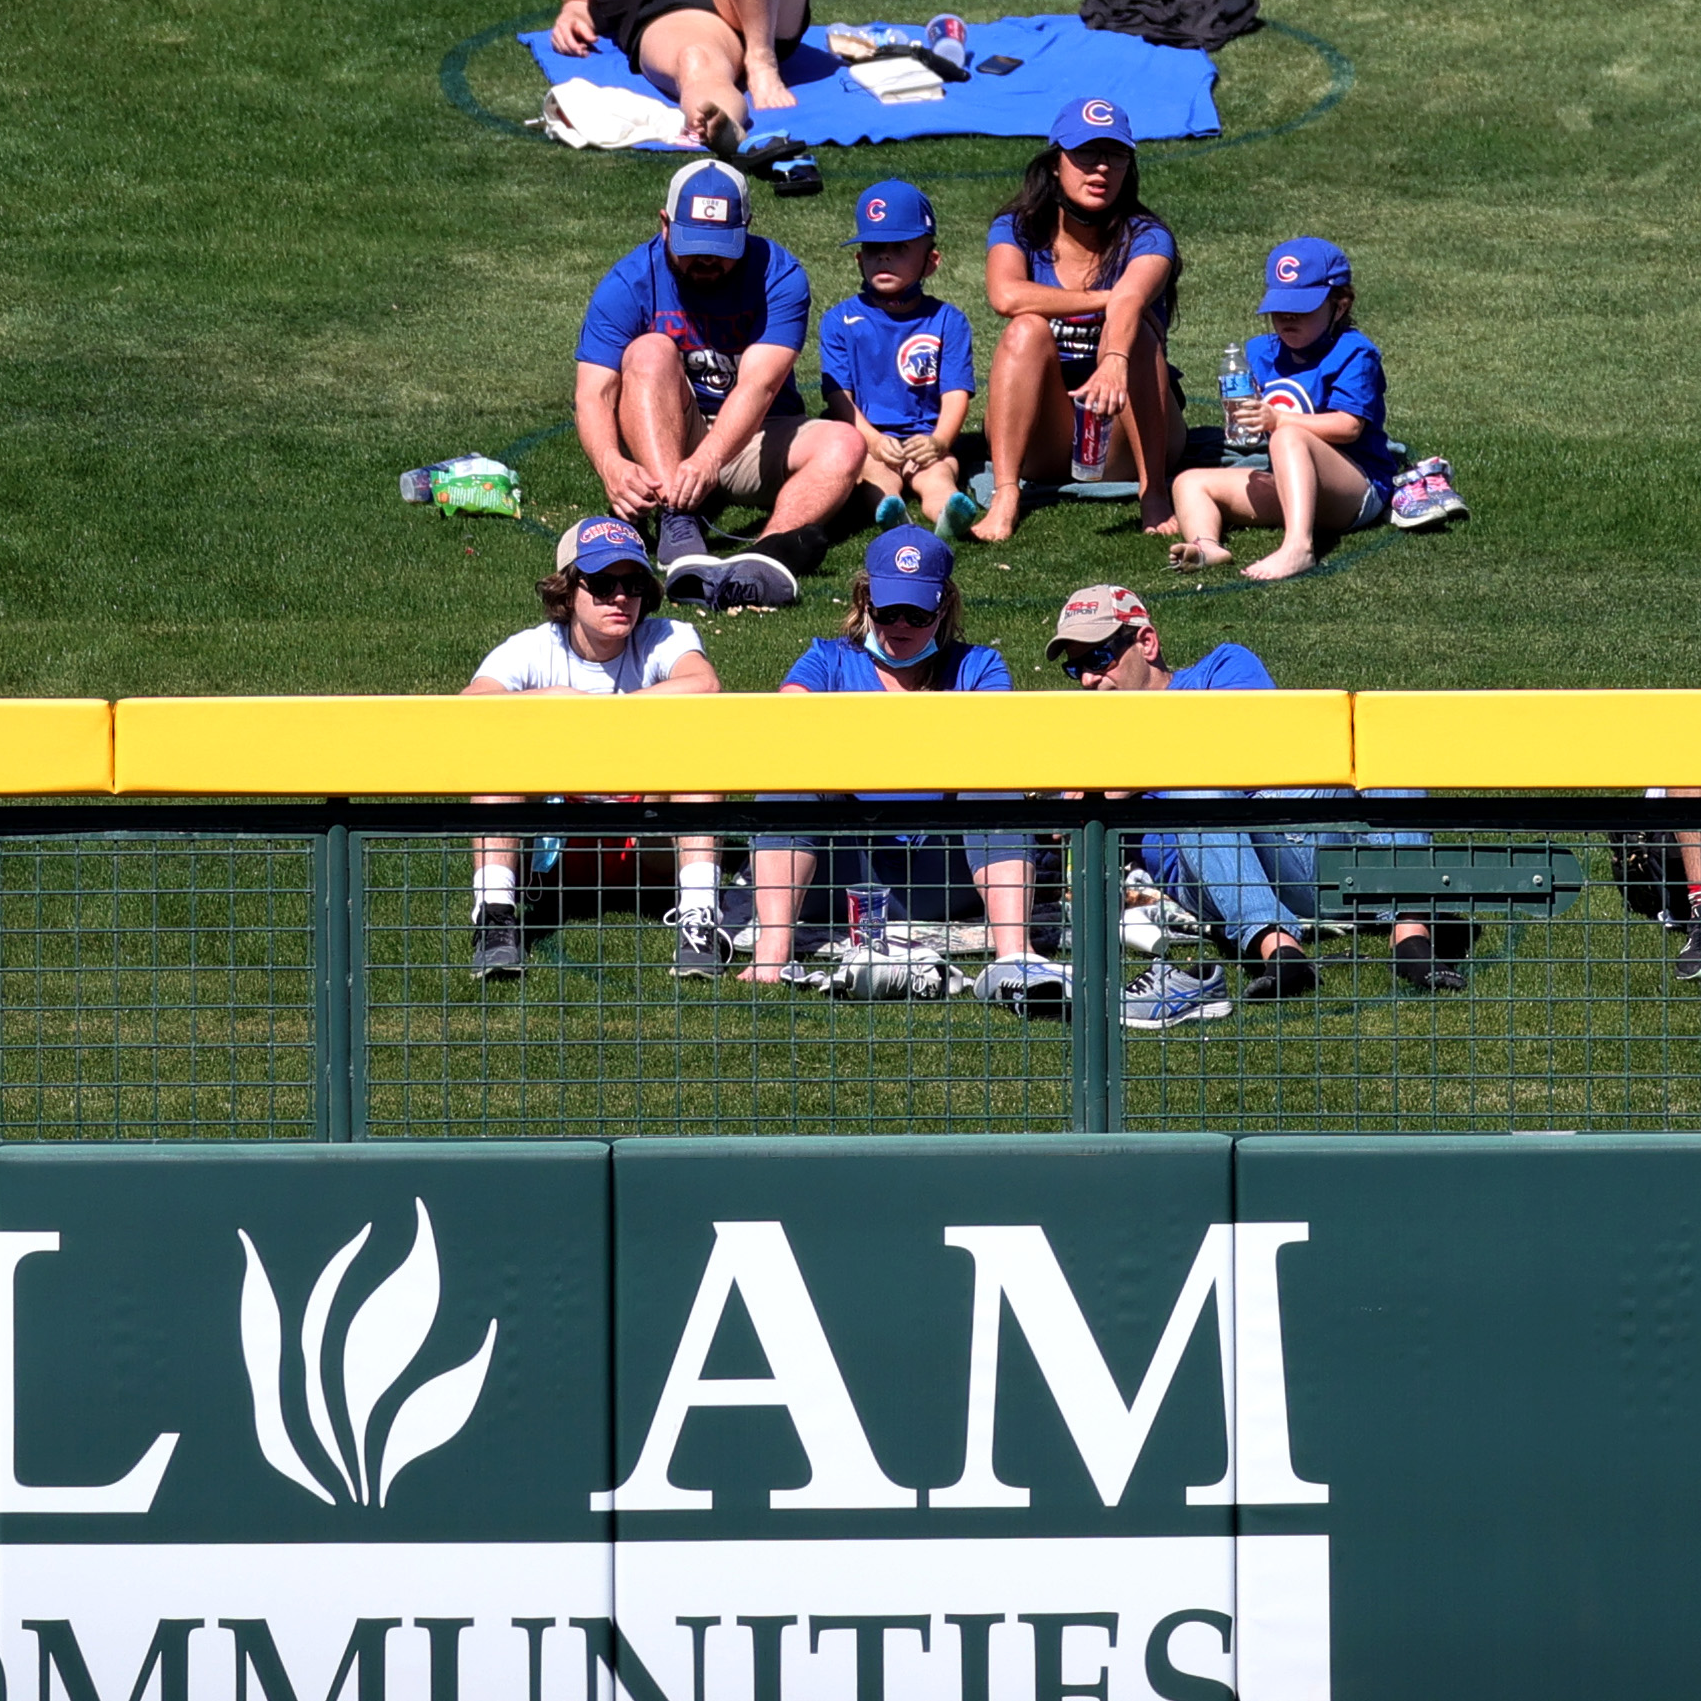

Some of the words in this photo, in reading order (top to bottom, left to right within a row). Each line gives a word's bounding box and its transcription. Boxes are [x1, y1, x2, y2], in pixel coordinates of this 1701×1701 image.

[866, 198, 887, 222] C
[1275, 255, 1300, 283] C
[589, 1219, 1332, 1512] AM
